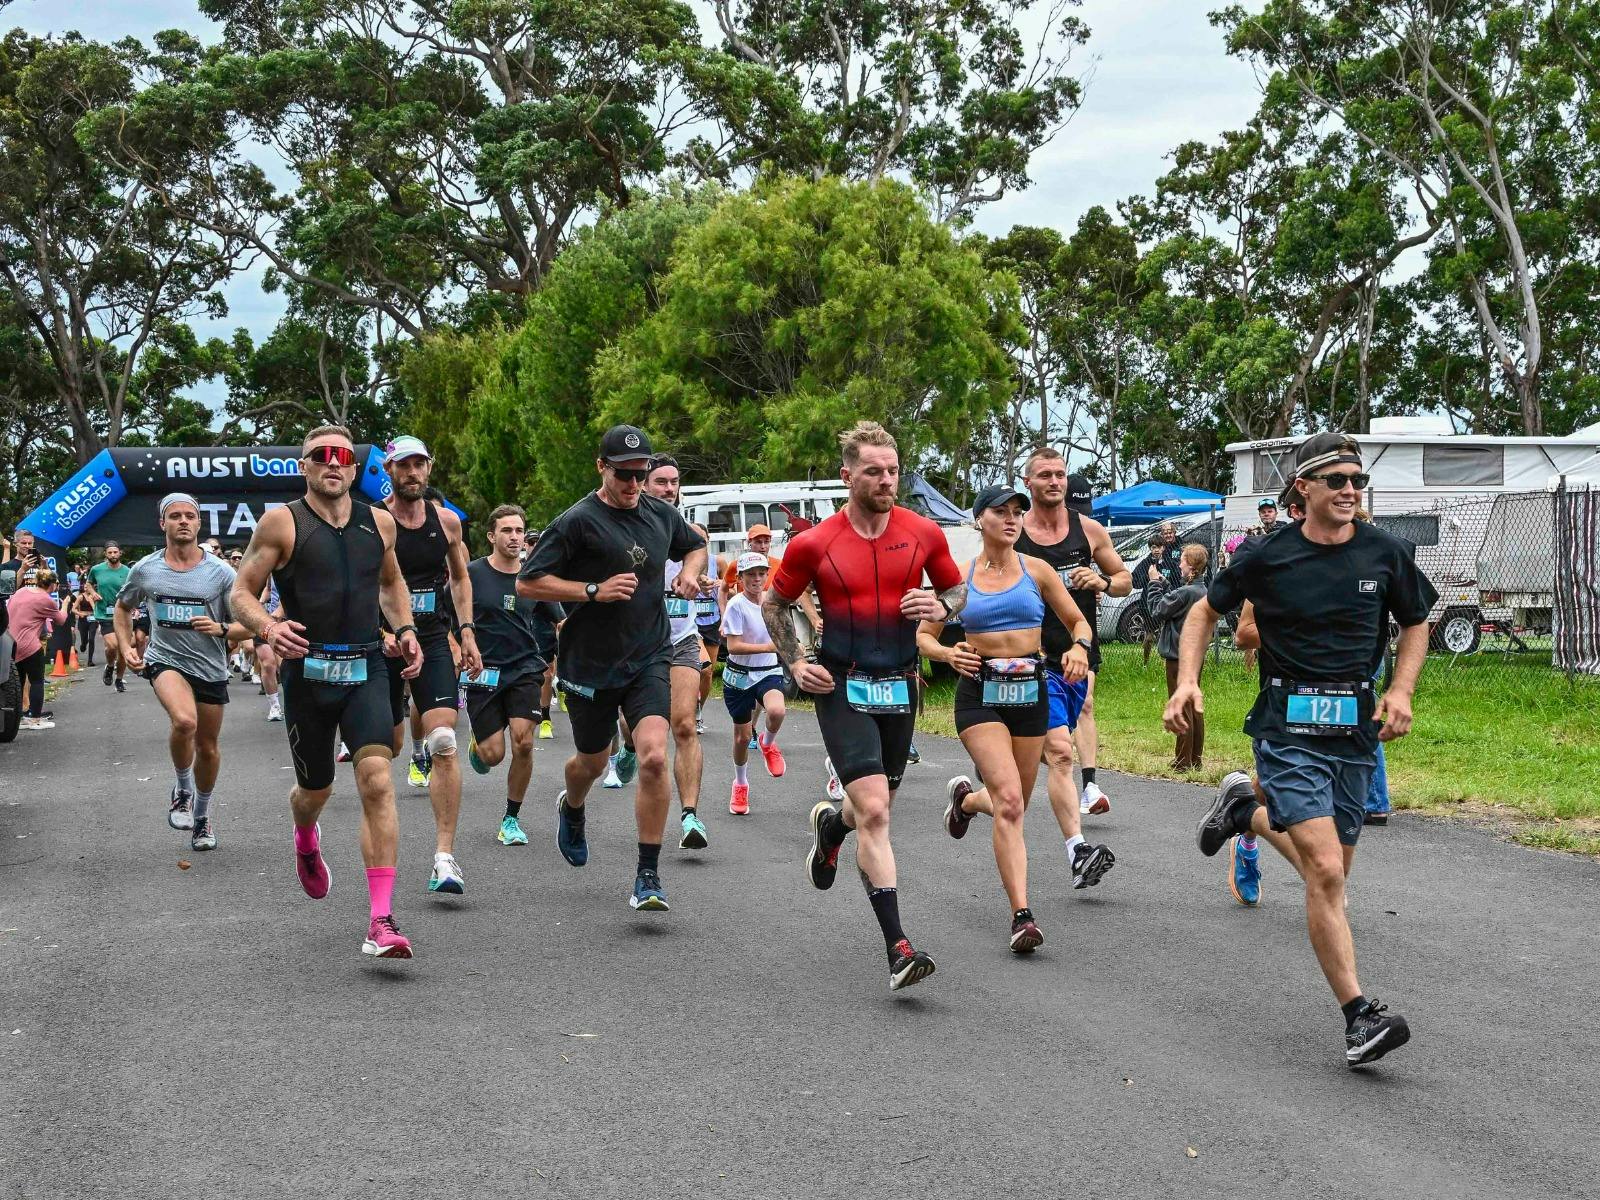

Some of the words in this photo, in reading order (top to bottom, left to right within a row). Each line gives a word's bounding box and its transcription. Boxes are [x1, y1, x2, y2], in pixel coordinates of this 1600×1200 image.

[166, 457, 247, 478] AUST
[55, 474, 98, 516] AUST
[57, 482, 112, 530] banners
[167, 605, 193, 621] 093
[667, 599, 682, 614] 74
[323, 661, 352, 681] 144
[865, 682, 893, 704] 108
[998, 683, 1025, 702] 091
[1310, 698, 1342, 723] 121
